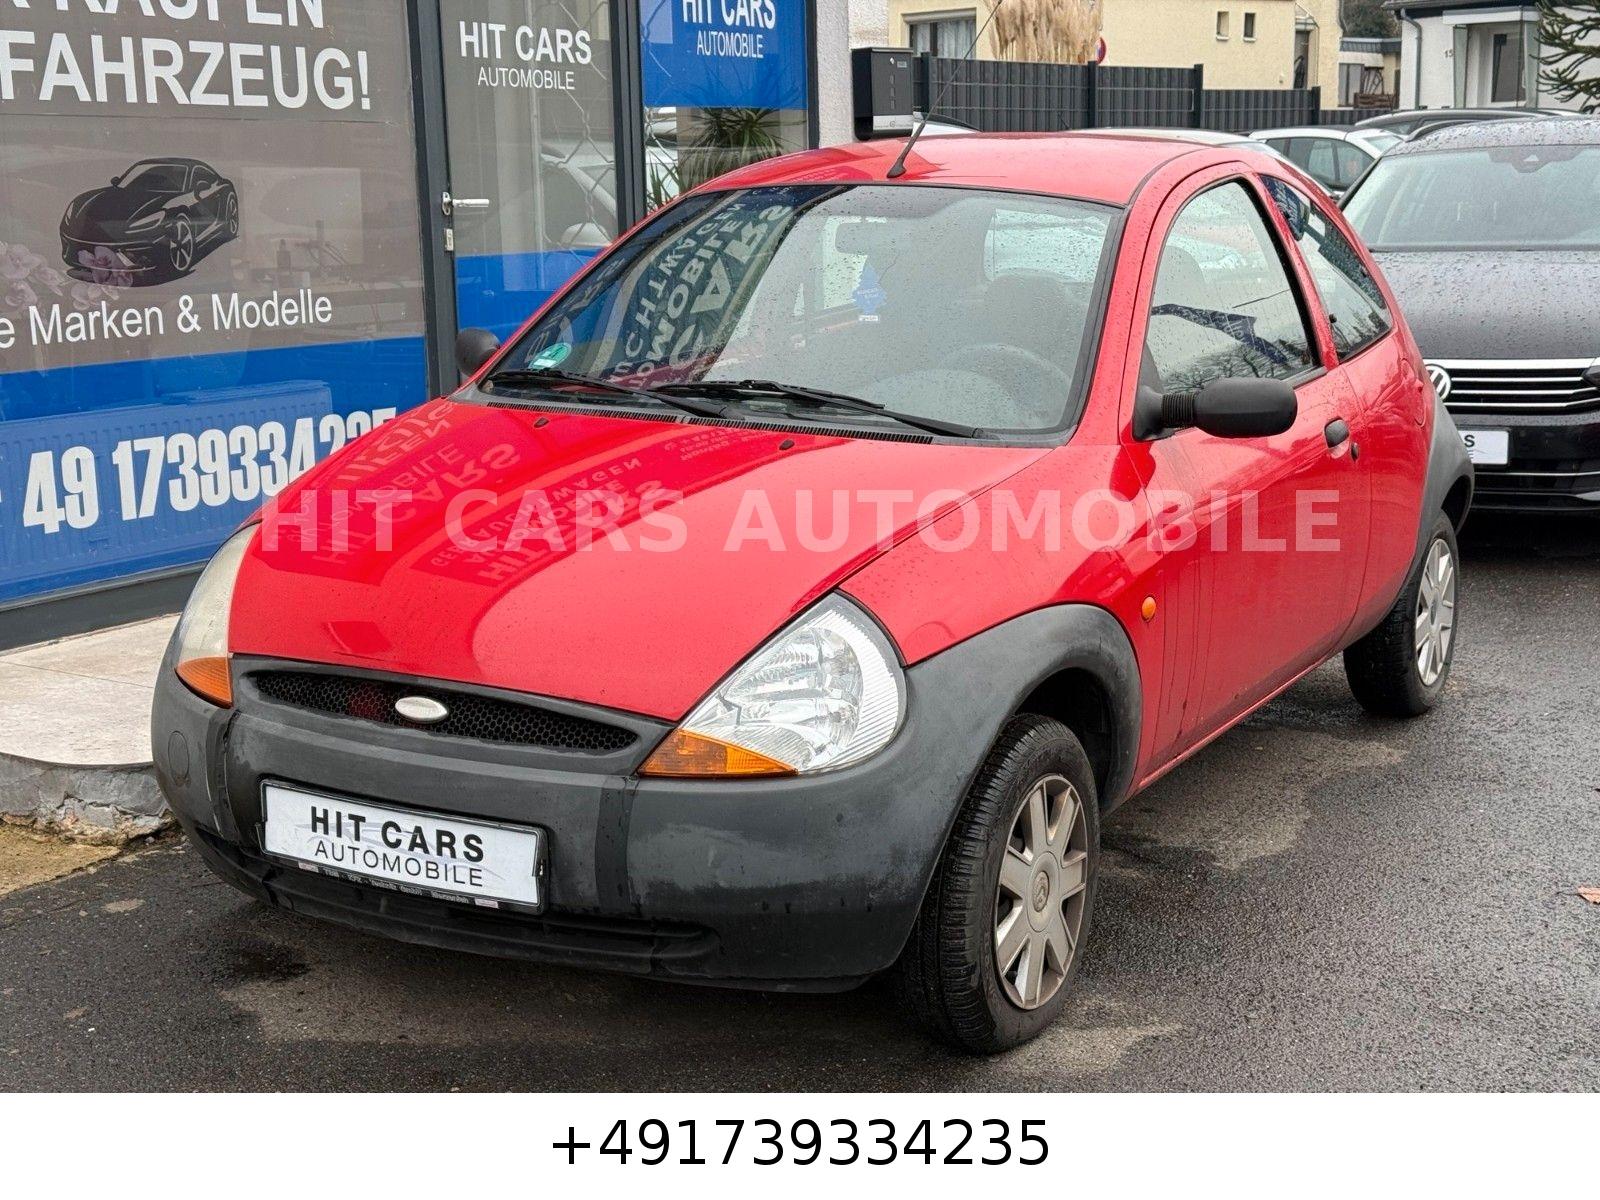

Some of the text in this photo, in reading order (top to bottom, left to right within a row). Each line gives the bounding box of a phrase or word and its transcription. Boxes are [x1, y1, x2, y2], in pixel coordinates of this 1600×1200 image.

[459, 21, 592, 65] HIT CARS
[696, 30, 764, 59] AUTOMOBILE
[0, 30, 371, 110] FAHRZEUG!
[477, 66, 575, 91] AUTOMOBILE
[29, 300, 164, 346] Marken
[177, 294, 202, 334] &
[211, 288, 333, 330] Modelle
[22, 446, 100, 535] 49
[311, 806, 485, 863] HIT CARS
[314, 839, 484, 888] AUTOMOBILE
